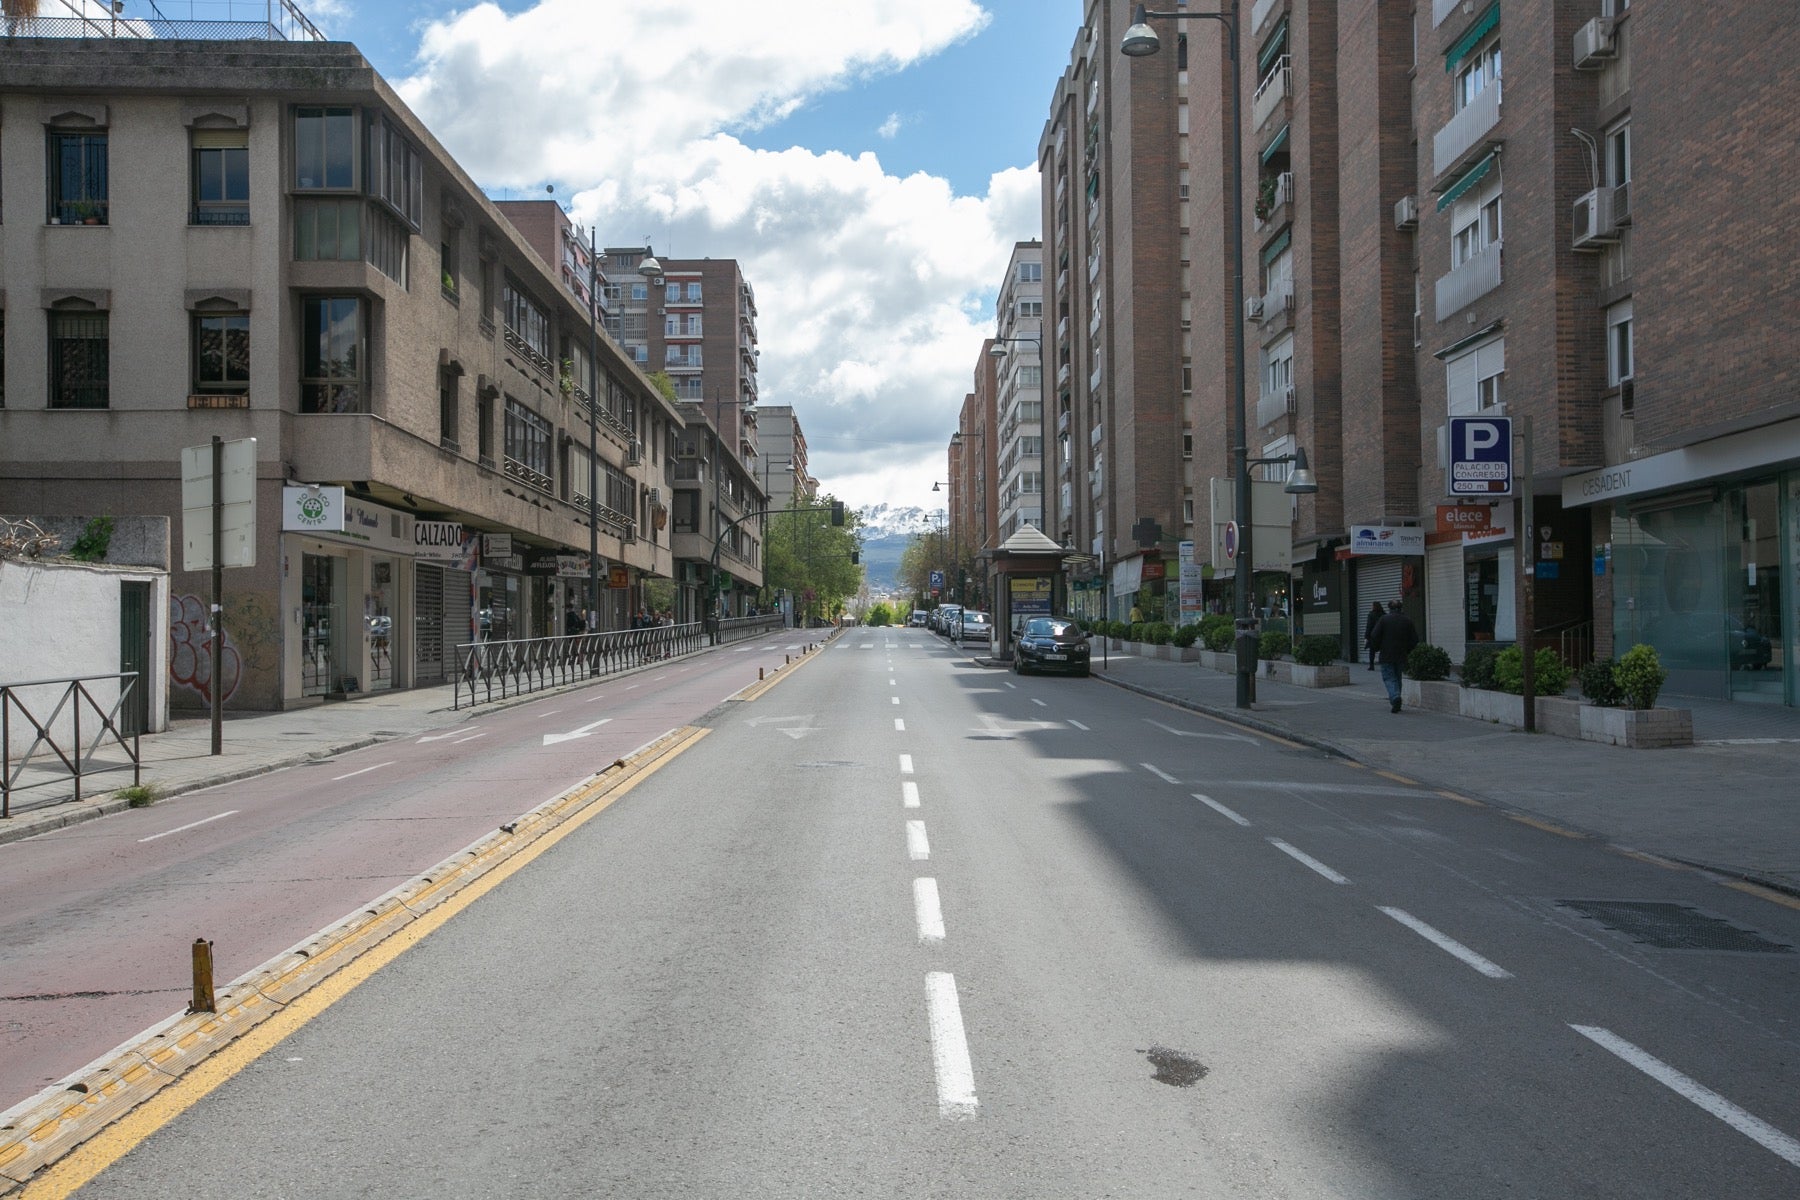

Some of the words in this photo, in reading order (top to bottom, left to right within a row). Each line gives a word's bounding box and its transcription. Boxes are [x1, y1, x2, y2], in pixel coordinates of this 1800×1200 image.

[1465, 422, 1499, 460] P
[1455, 463, 1490, 471] PALACIO
[1494, 463, 1506, 471] DE
[1455, 471, 1506, 479] CONGRESOS
[1456, 482, 1473, 490] 250
[1582, 468, 1632, 496] CESADENT
[296, 493, 308, 506] BIO
[318, 492, 330, 508] ECO
[297, 513, 328, 526] CENTRO
[1445, 508, 1483, 522] elece
[414, 523, 463, 547] CALZADO
[1355, 539, 1394, 547] alminares
